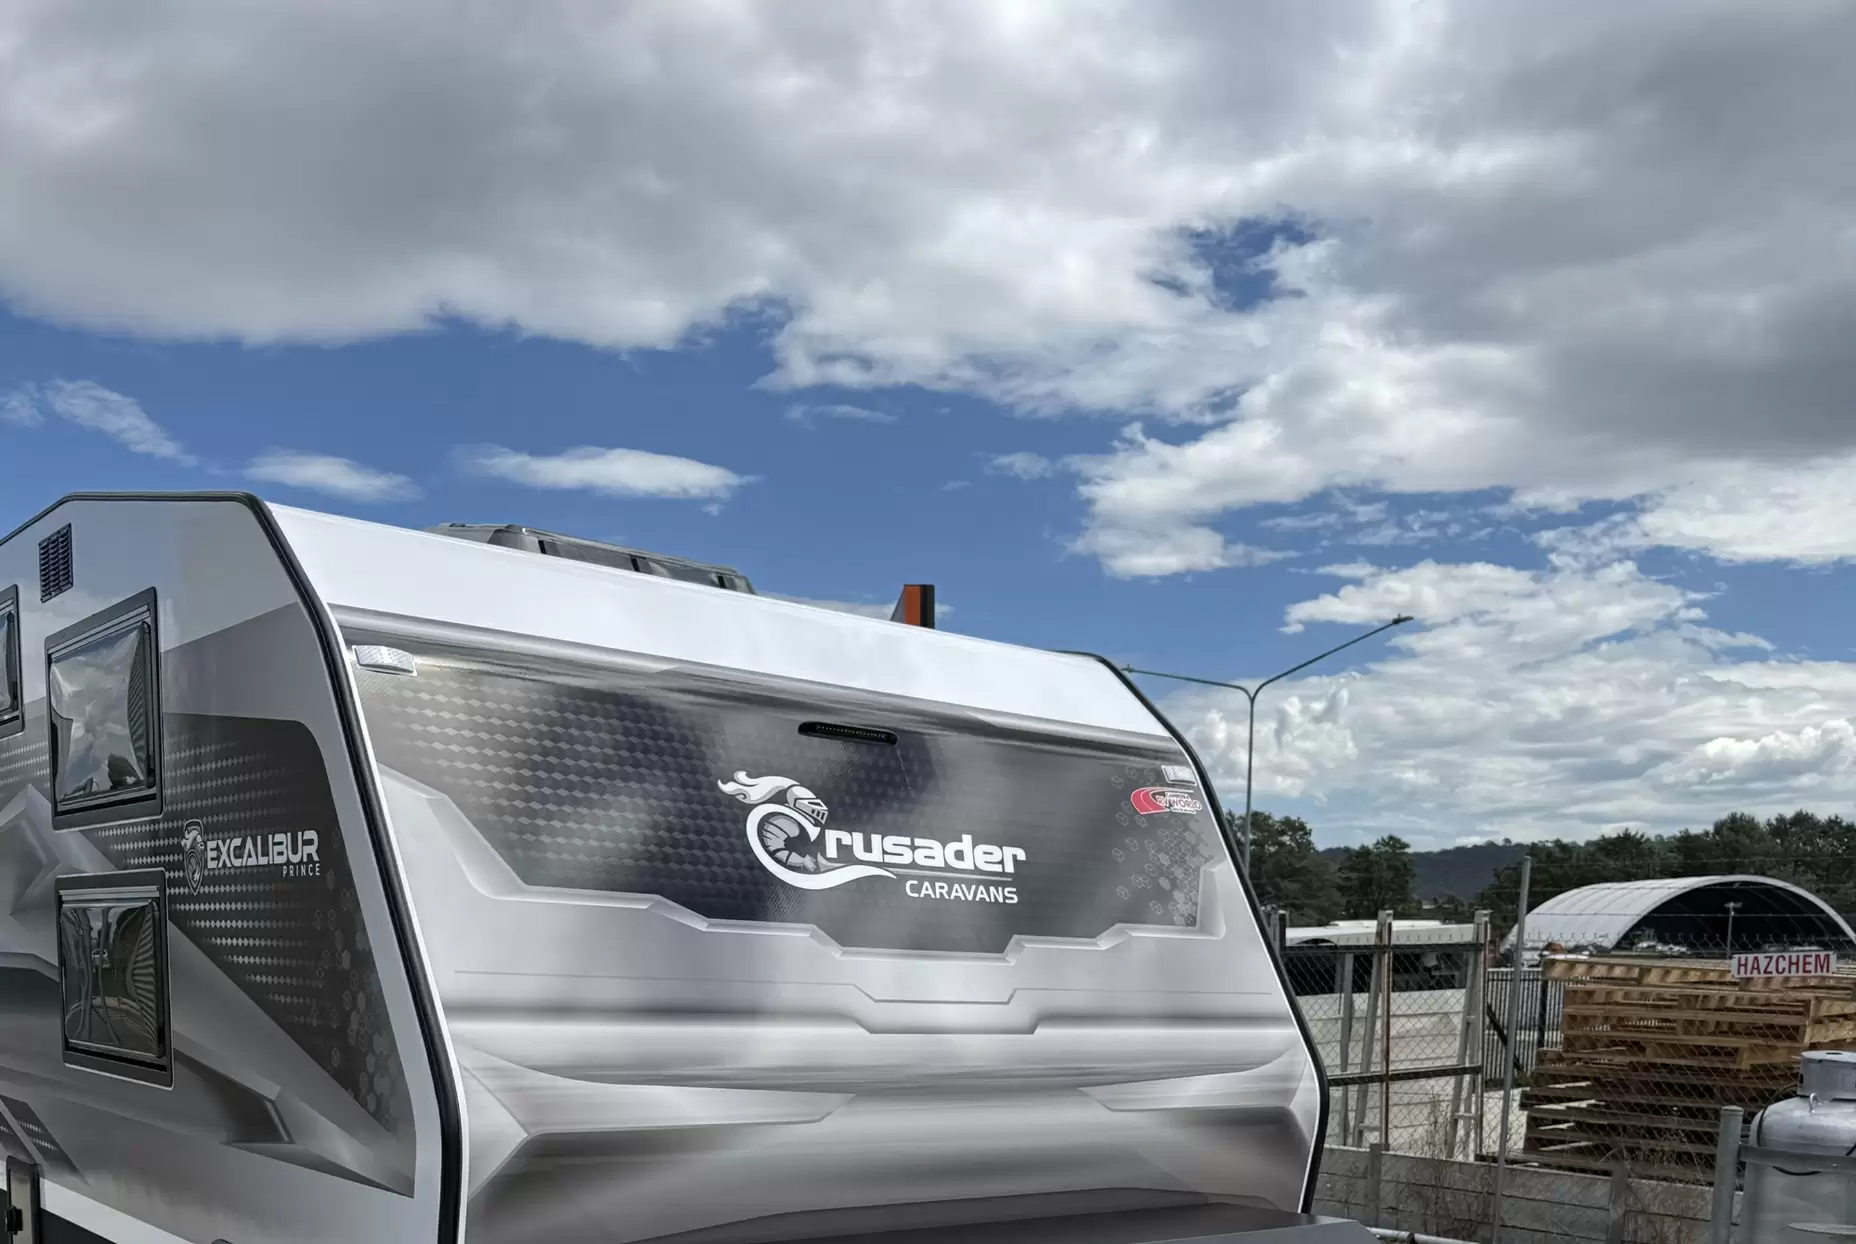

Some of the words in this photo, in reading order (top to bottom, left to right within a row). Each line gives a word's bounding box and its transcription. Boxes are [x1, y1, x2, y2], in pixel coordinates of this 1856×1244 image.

[206, 830, 320, 869] EXCALIBUR
[282, 863, 320, 877] PRINCE
[905, 880, 1018, 904] CARAVANS
[1737, 953, 1830, 975] HAZCHEM
